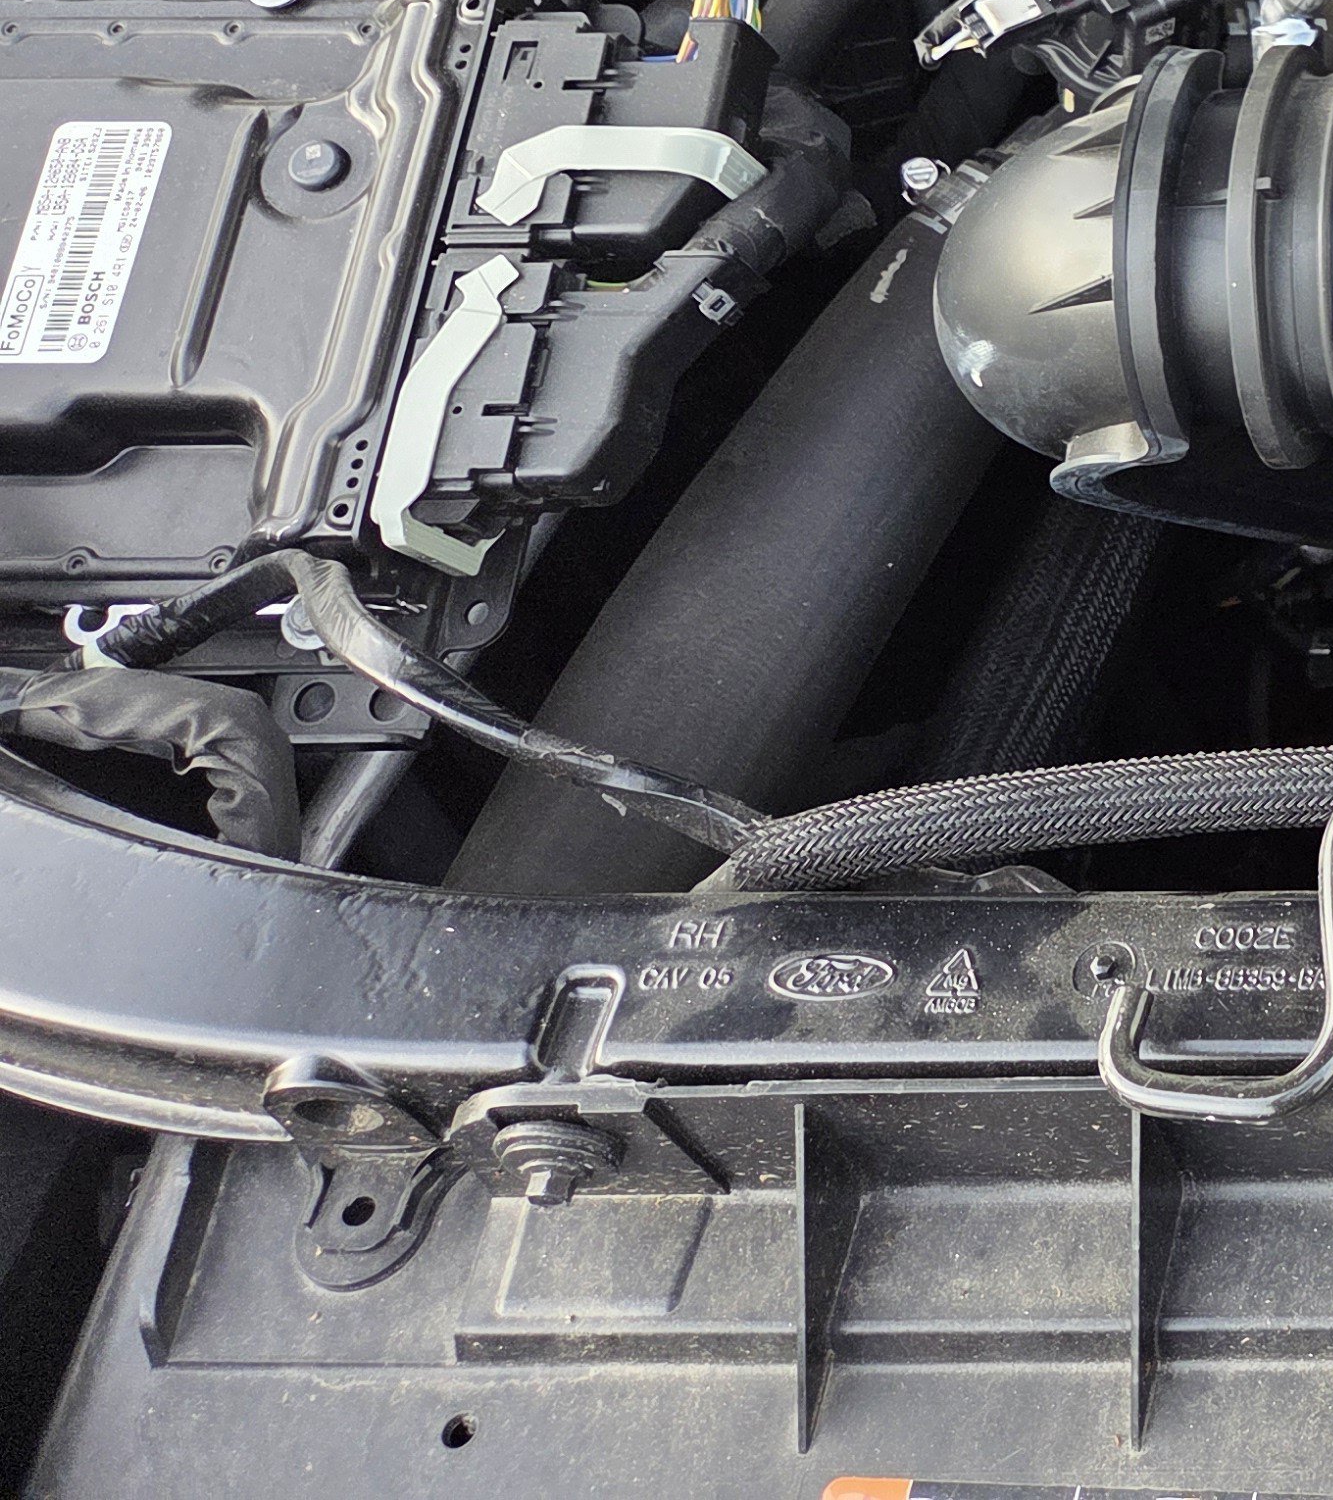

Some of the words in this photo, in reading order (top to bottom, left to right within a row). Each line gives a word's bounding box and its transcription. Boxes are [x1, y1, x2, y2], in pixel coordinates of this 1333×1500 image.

[113, 176, 128, 200] Made
[124, 127, 143, 164] Romania
[0, 278, 36, 350] FoMoCo
[76, 270, 106, 324] BOSCH
[93, 314, 110, 333] 261
[669, 919, 727, 948] RH
[638, 966, 688, 990] CAV
[699, 966, 733, 990] 05
